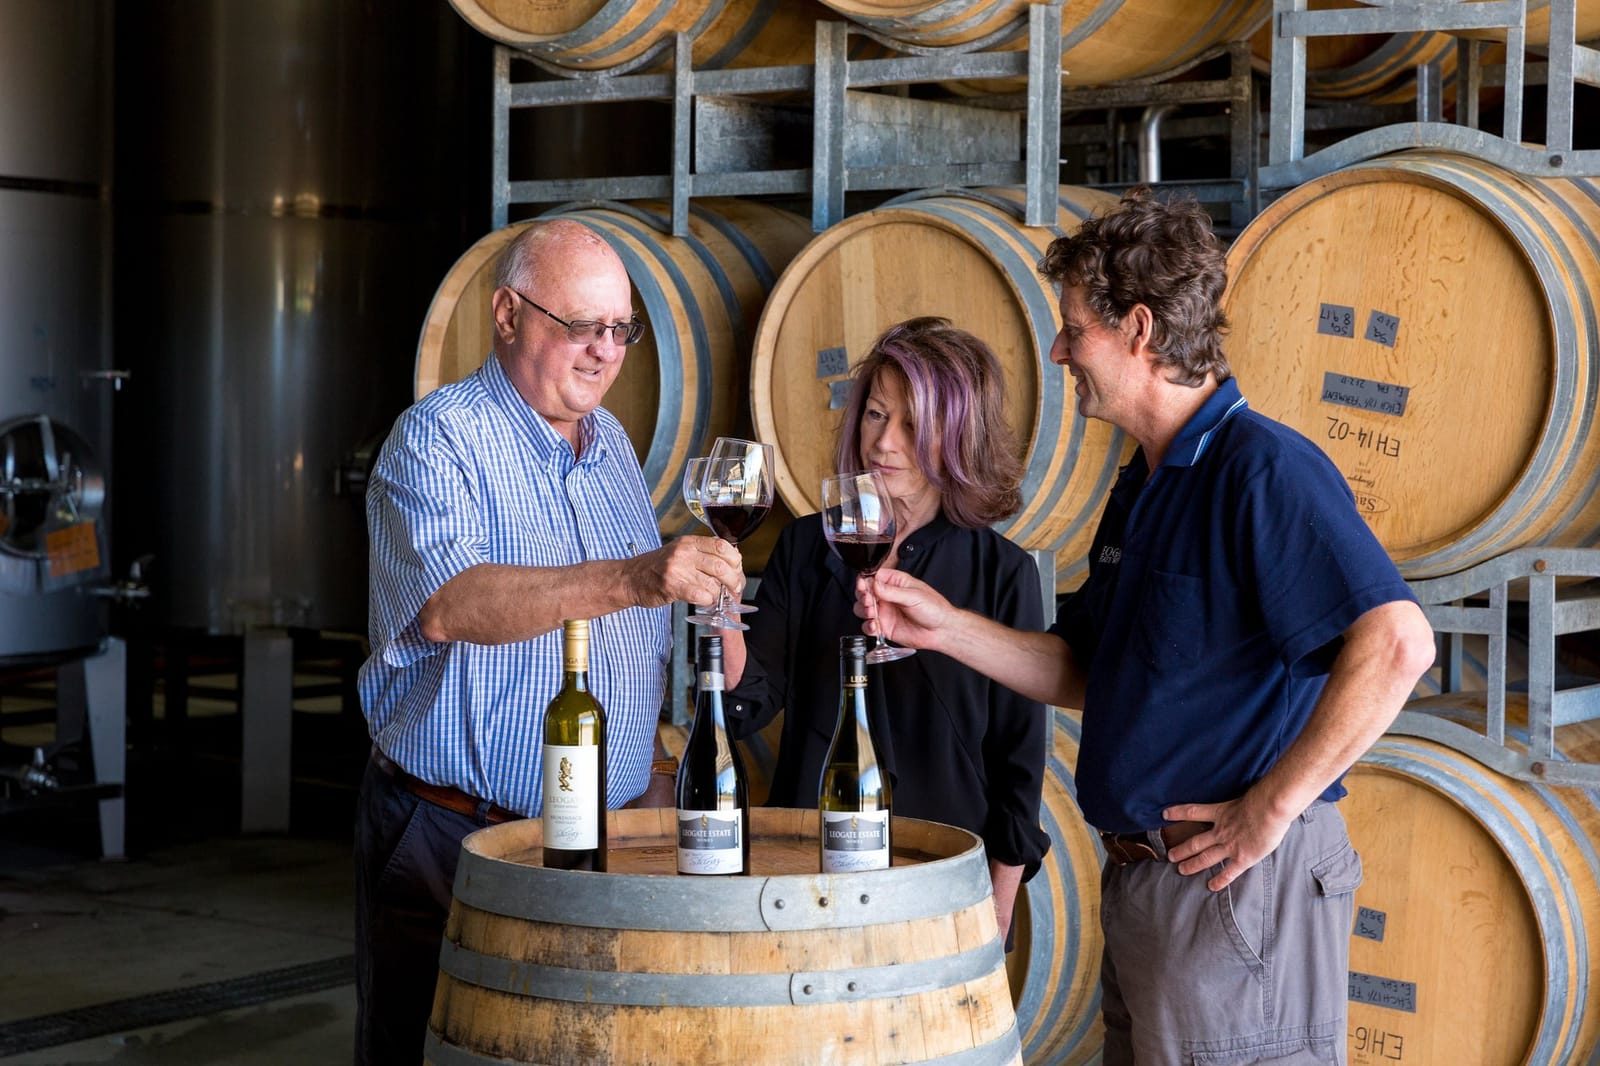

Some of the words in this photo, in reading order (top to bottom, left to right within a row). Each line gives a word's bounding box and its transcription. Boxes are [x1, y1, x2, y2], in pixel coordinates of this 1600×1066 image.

[708, 829, 732, 838] ESTATE
[828, 830, 856, 839] LEOGATE
[858, 830, 881, 839] ESTATE
